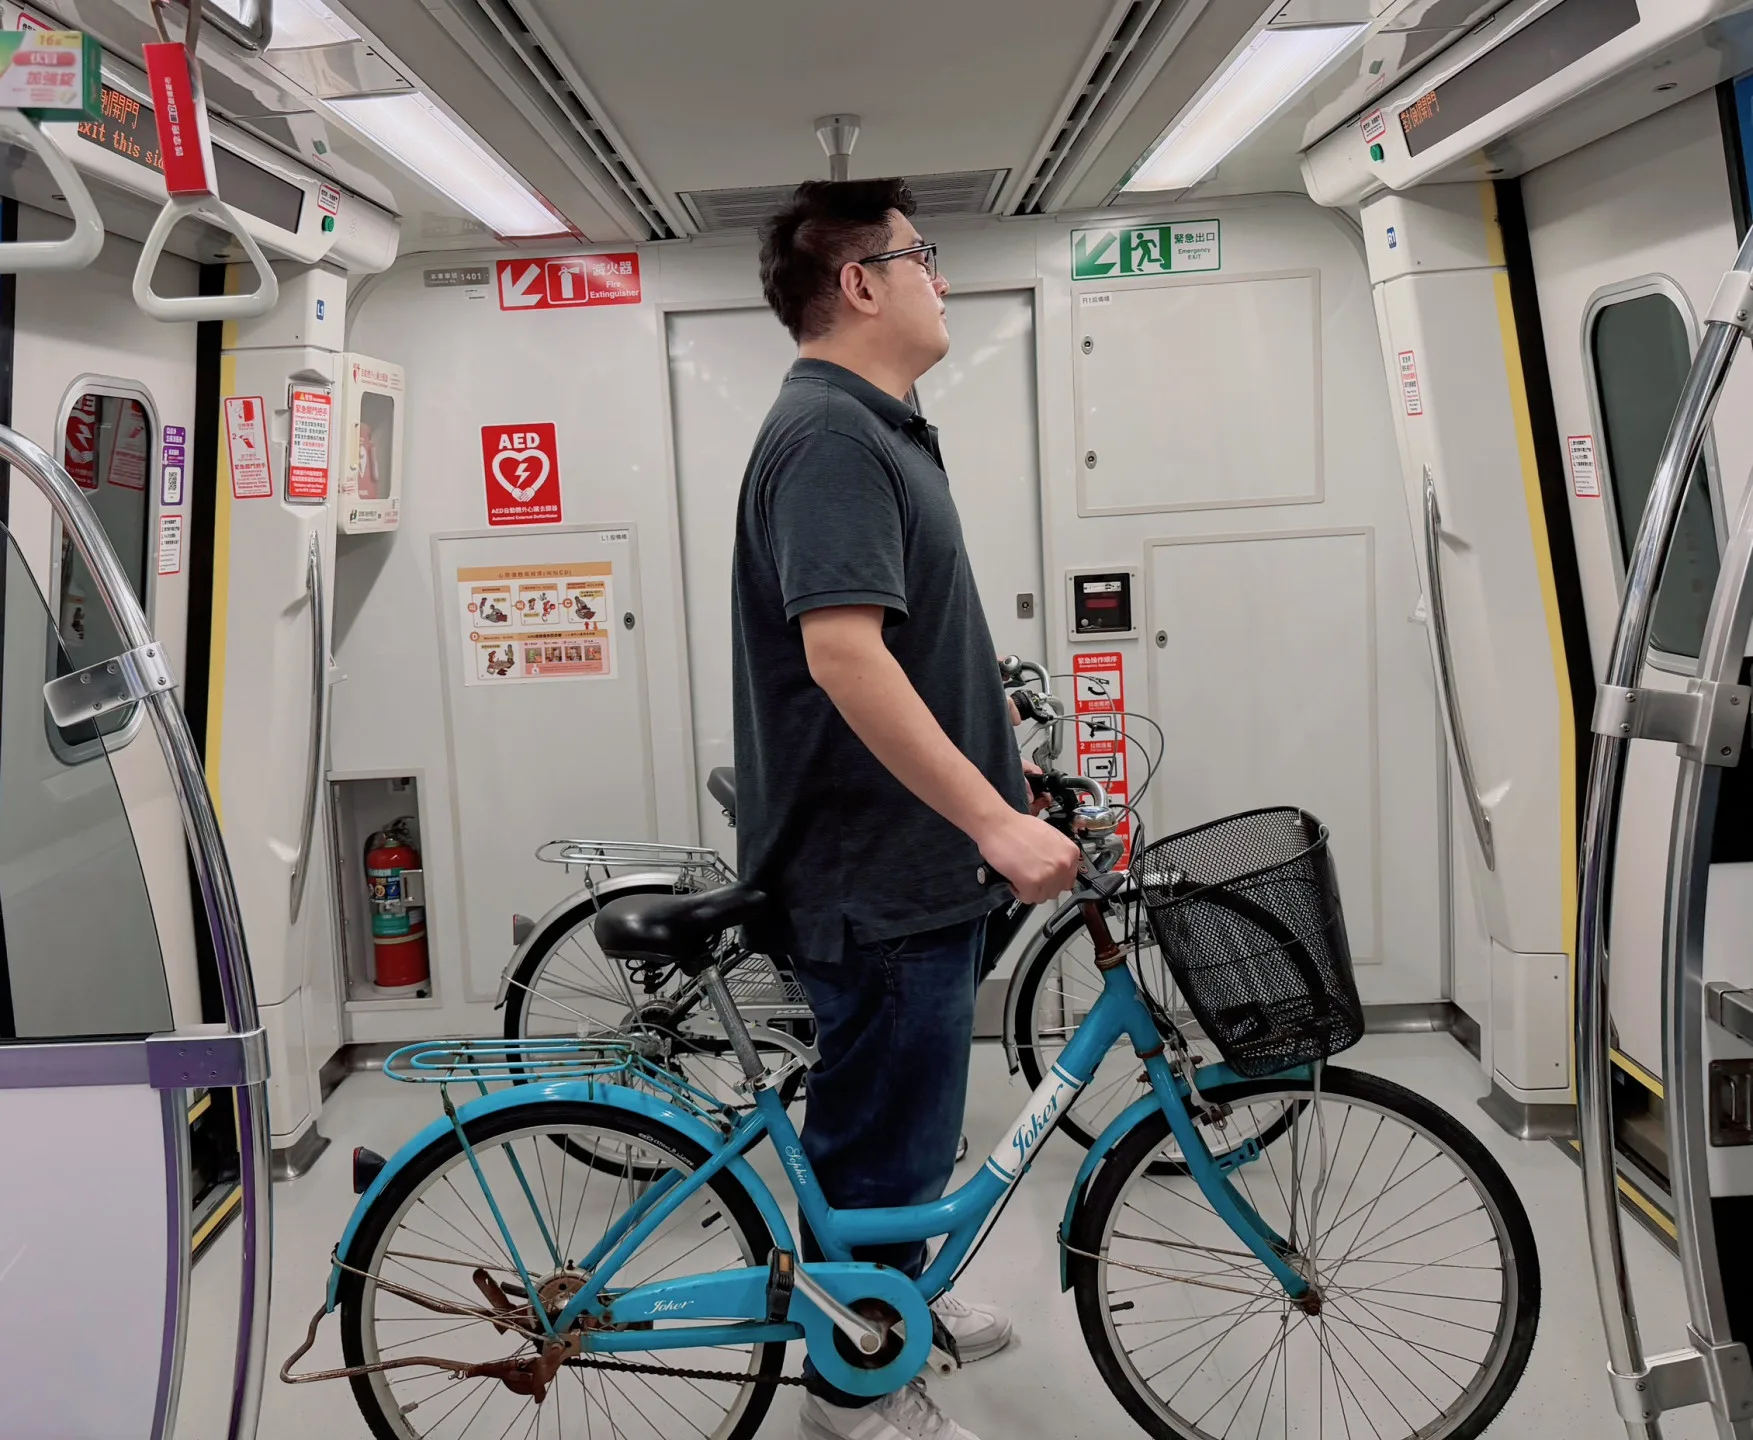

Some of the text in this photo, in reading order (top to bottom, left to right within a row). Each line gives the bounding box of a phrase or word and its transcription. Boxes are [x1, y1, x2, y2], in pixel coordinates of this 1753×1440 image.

[113, 130, 140, 158] this
[1174, 231, 1216, 244] 緊急出口
[1178, 247, 1212, 255] Emergency
[592, 260, 633, 277] 滅火器
[460, 272, 482, 281] 1401
[606, 280, 622, 289] Fire
[589, 289, 640, 300] Extinguisher
[498, 432, 541, 450] AED
[1012, 1083, 1064, 1171] Joker
[785, 1145, 807, 1185] Sophia
[644, 1300, 695, 1315] Joker
